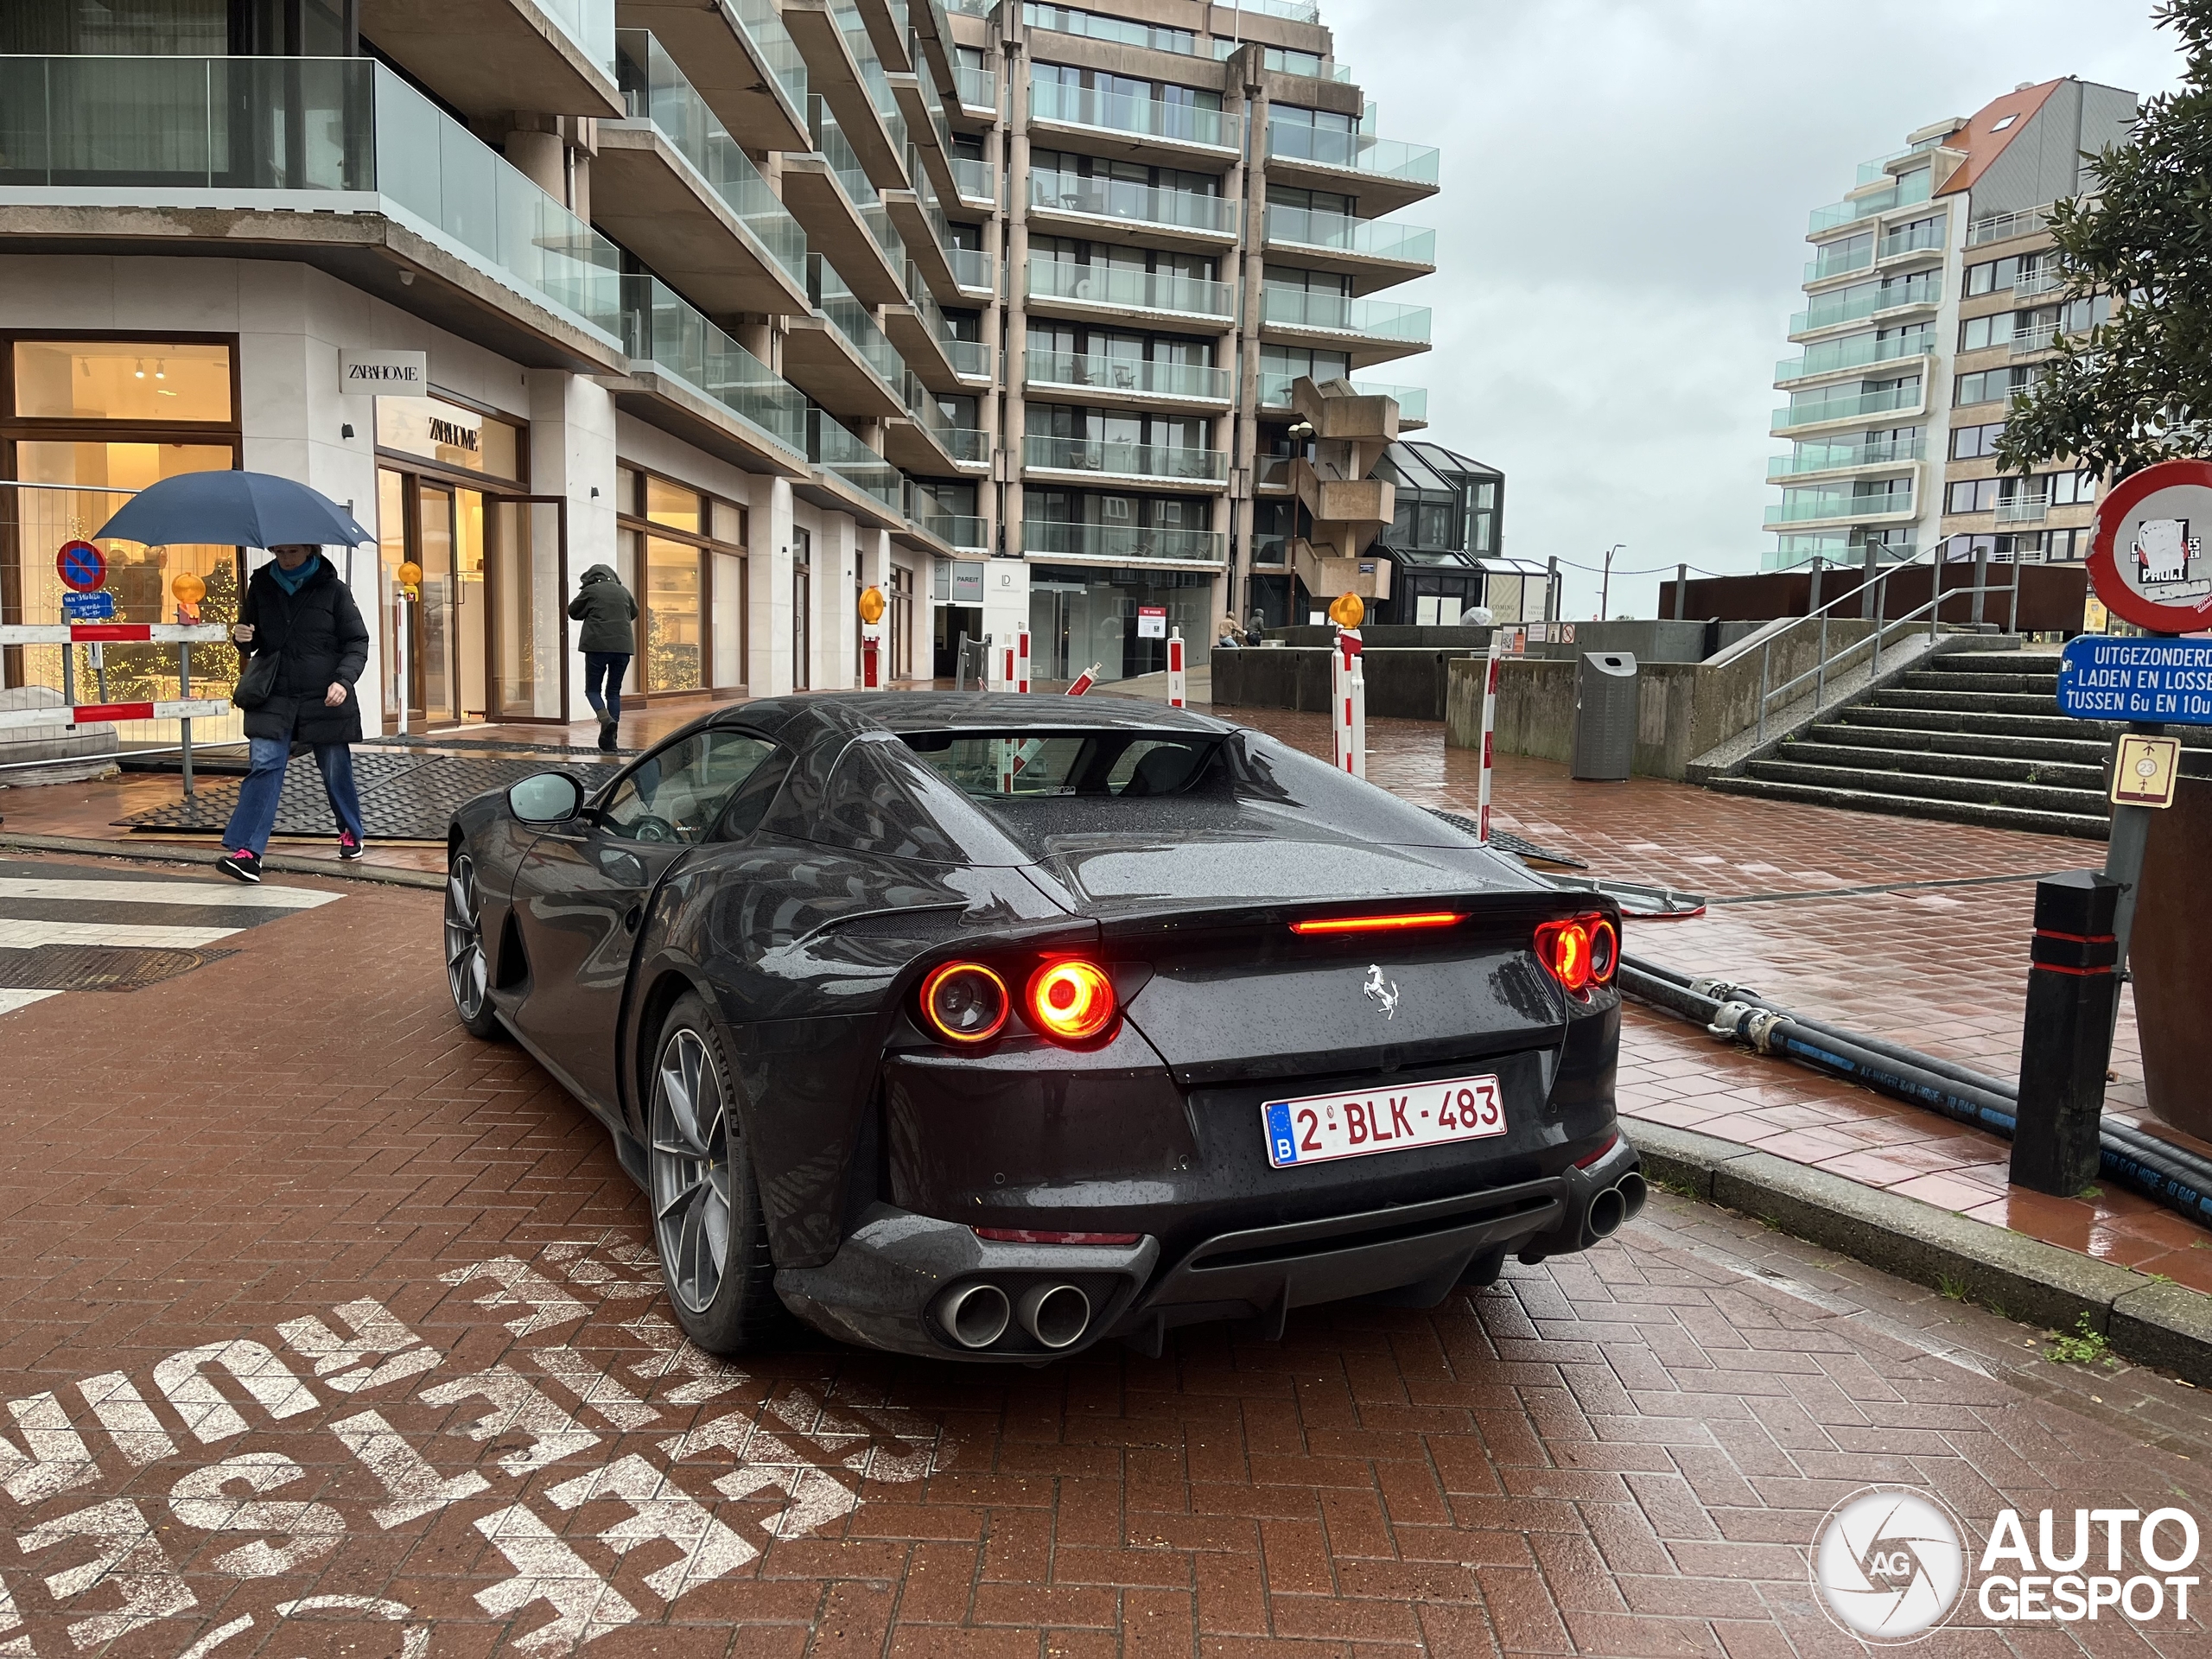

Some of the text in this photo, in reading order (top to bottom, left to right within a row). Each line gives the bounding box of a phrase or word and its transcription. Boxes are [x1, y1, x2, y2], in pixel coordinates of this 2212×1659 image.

[2094, 646, 2212, 667] UITGEZONDERD
[2078, 669, 2131, 688] LADEN
[2137, 671, 2159, 689] EN
[2066, 690, 2210, 715] TUSSEN 6u EN 10u
[2139, 762, 2153, 773] 23
[708, 1026, 739, 1129] MICHELIN
[1916, 1083, 1940, 1103] HOSE
[1948, 1095, 1957, 1109] 10
[1958, 1099, 1977, 1116] BAR
[1296, 1085, 1499, 1152] 2-BLK-483
[1277, 1139, 1292, 1160] B
[2138, 1166, 2162, 1188] HOSE
[2167, 1179, 2178, 1196] 10
[2177, 1185, 2197, 1205] BAR
